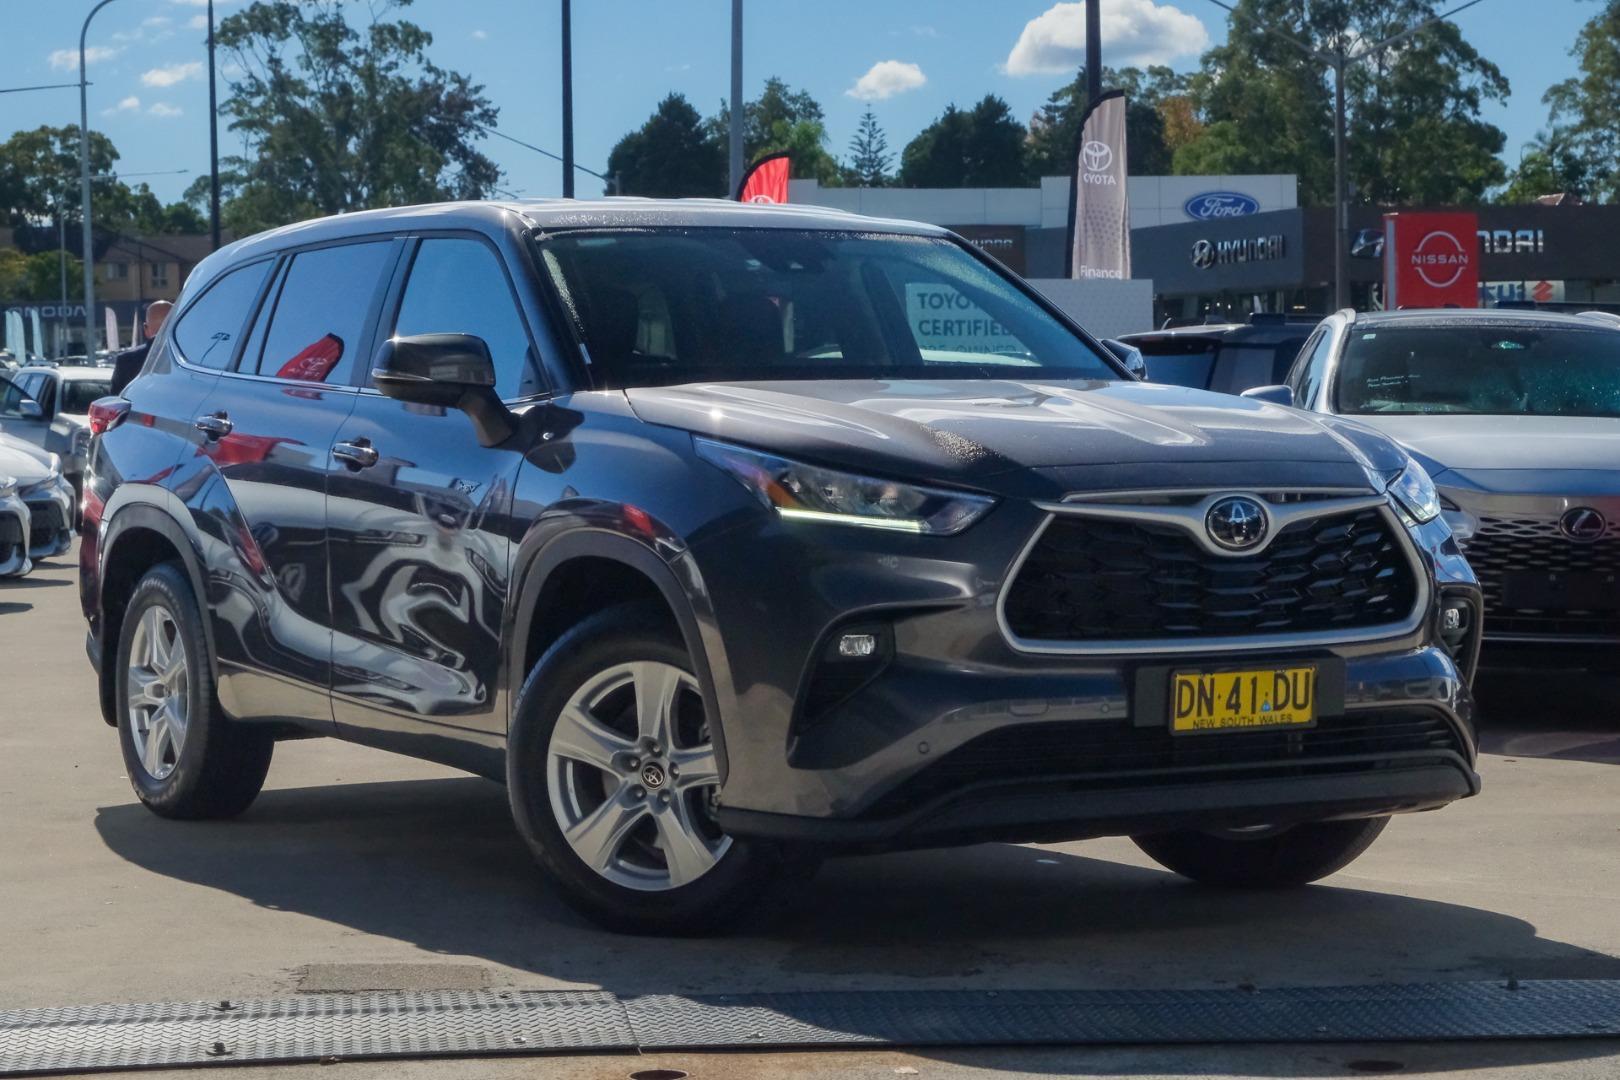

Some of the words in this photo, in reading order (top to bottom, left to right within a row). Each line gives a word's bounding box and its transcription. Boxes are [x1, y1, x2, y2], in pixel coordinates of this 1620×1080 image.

[1083, 174, 1116, 185] OYOTA
[1200, 197, 1245, 217] Ford
[1218, 235, 1284, 264] HYUNDAI
[1477, 229, 1544, 253] NDAI
[1411, 254, 1469, 264] NISSAN
[1080, 266, 1122, 279] Finance
[916, 292, 978, 310] TOYO
[1192, 718, 1216, 729] NEW
[1220, 716, 1254, 728] SOUTH
[1259, 713, 1293, 726] WALES
